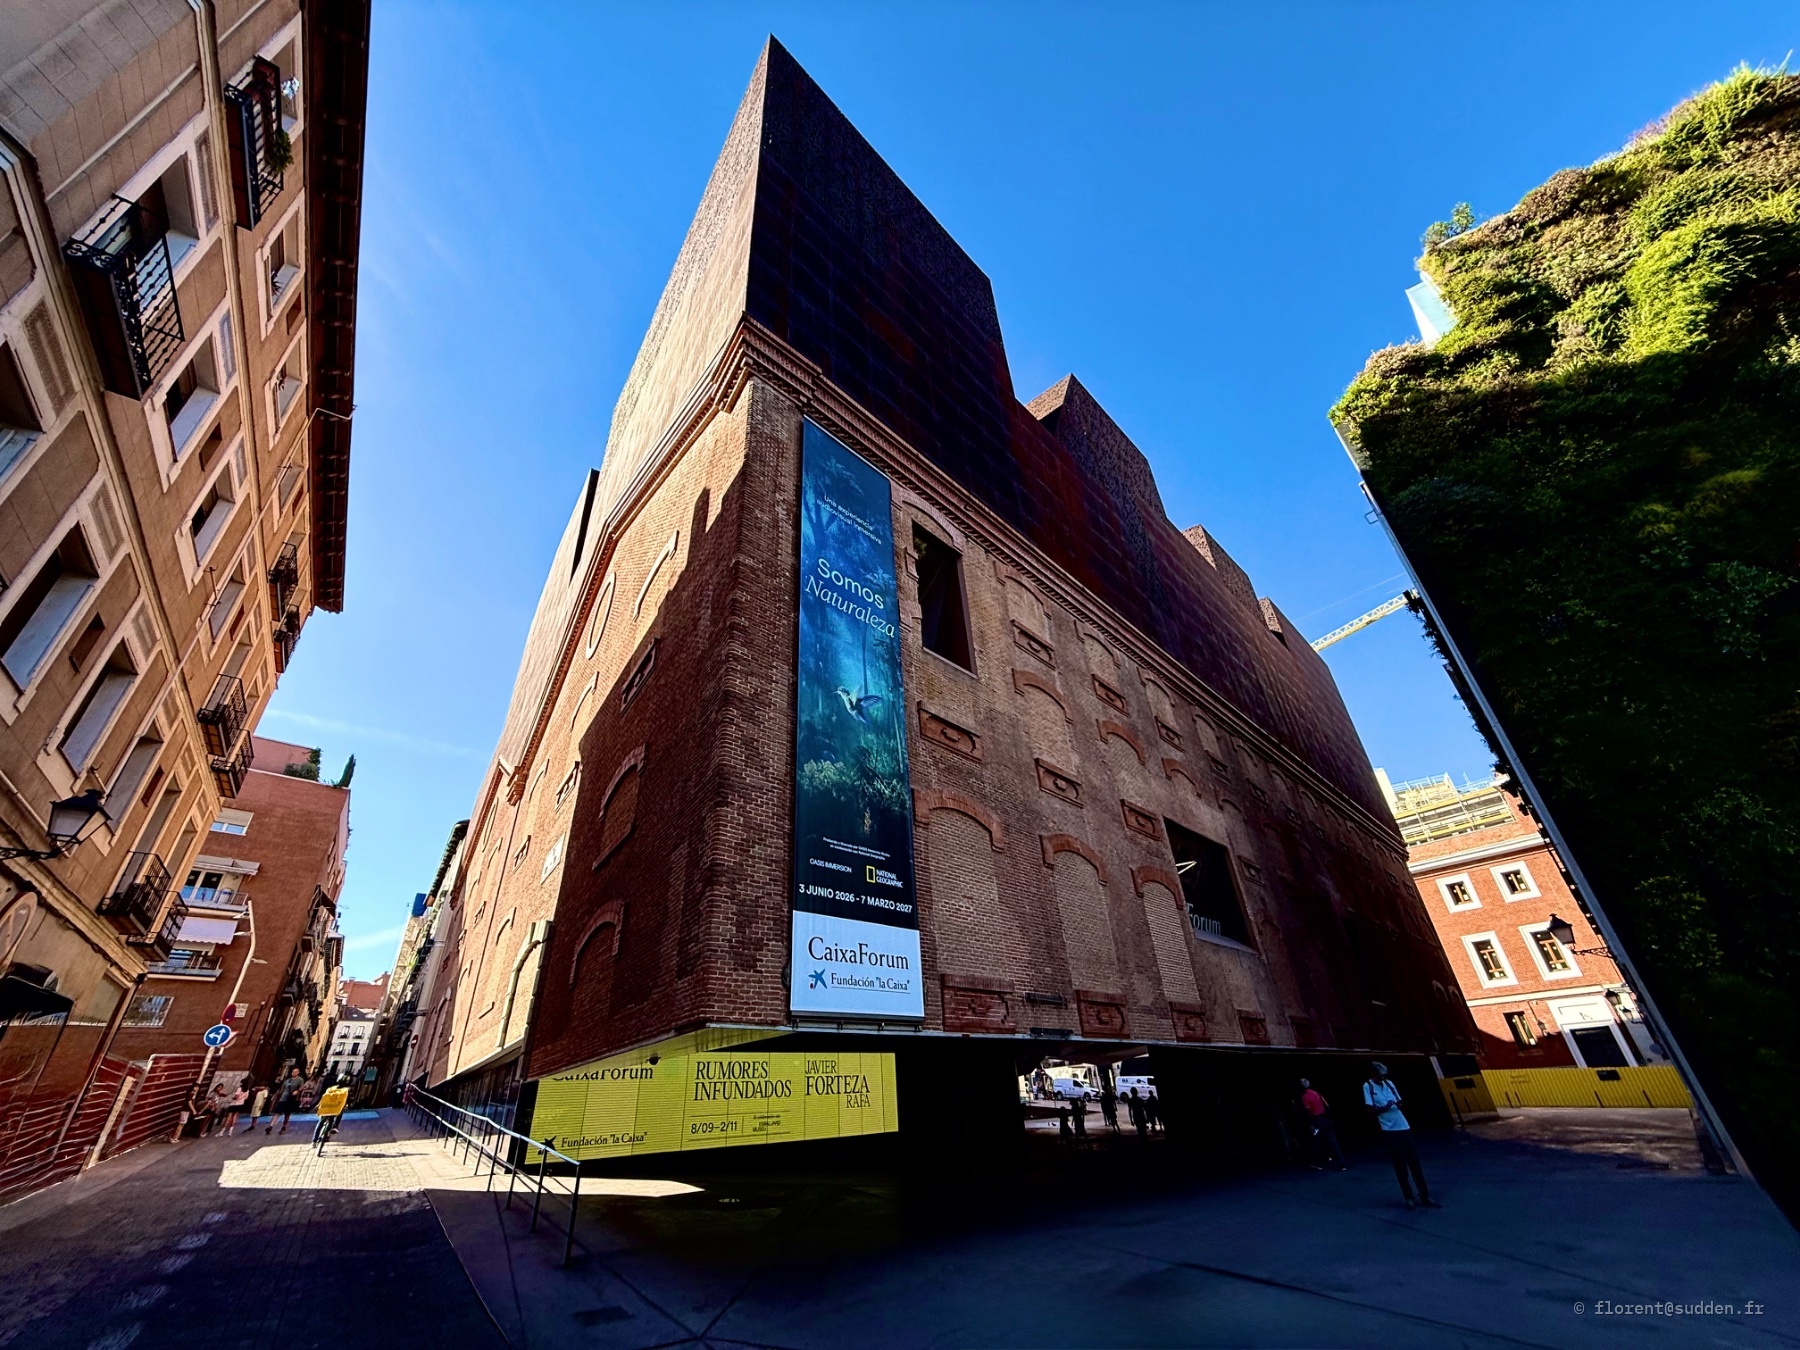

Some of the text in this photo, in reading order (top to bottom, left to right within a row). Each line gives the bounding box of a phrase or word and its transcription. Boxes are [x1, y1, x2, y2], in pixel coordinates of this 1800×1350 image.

[817, 558, 884, 609] Somos
[804, 574, 895, 638] Naturaleza
[876, 869, 898, 880] NATIONAL
[876, 876, 904, 888] GEOGRAPHIC
[799, 883, 805, 893] 3
[806, 885, 834, 898] JUNIO
[835, 890, 855, 902] 2026
[861, 896, 866, 904] 7
[867, 896, 895, 910] MARZO
[896, 902, 913, 913] 2027
[808, 936, 909, 970] CaixaForum
[831, 972, 874, 988] Fundación
[695, 1060, 768, 1080] RUMORES
[804, 1059, 837, 1075] JAVIER
[693, 1079, 792, 1101] INFUNDADOS
[804, 1074, 871, 1096] FORTEZA
[846, 1094, 871, 1109] RAFA
[561, 1135, 608, 1148] Fundación
